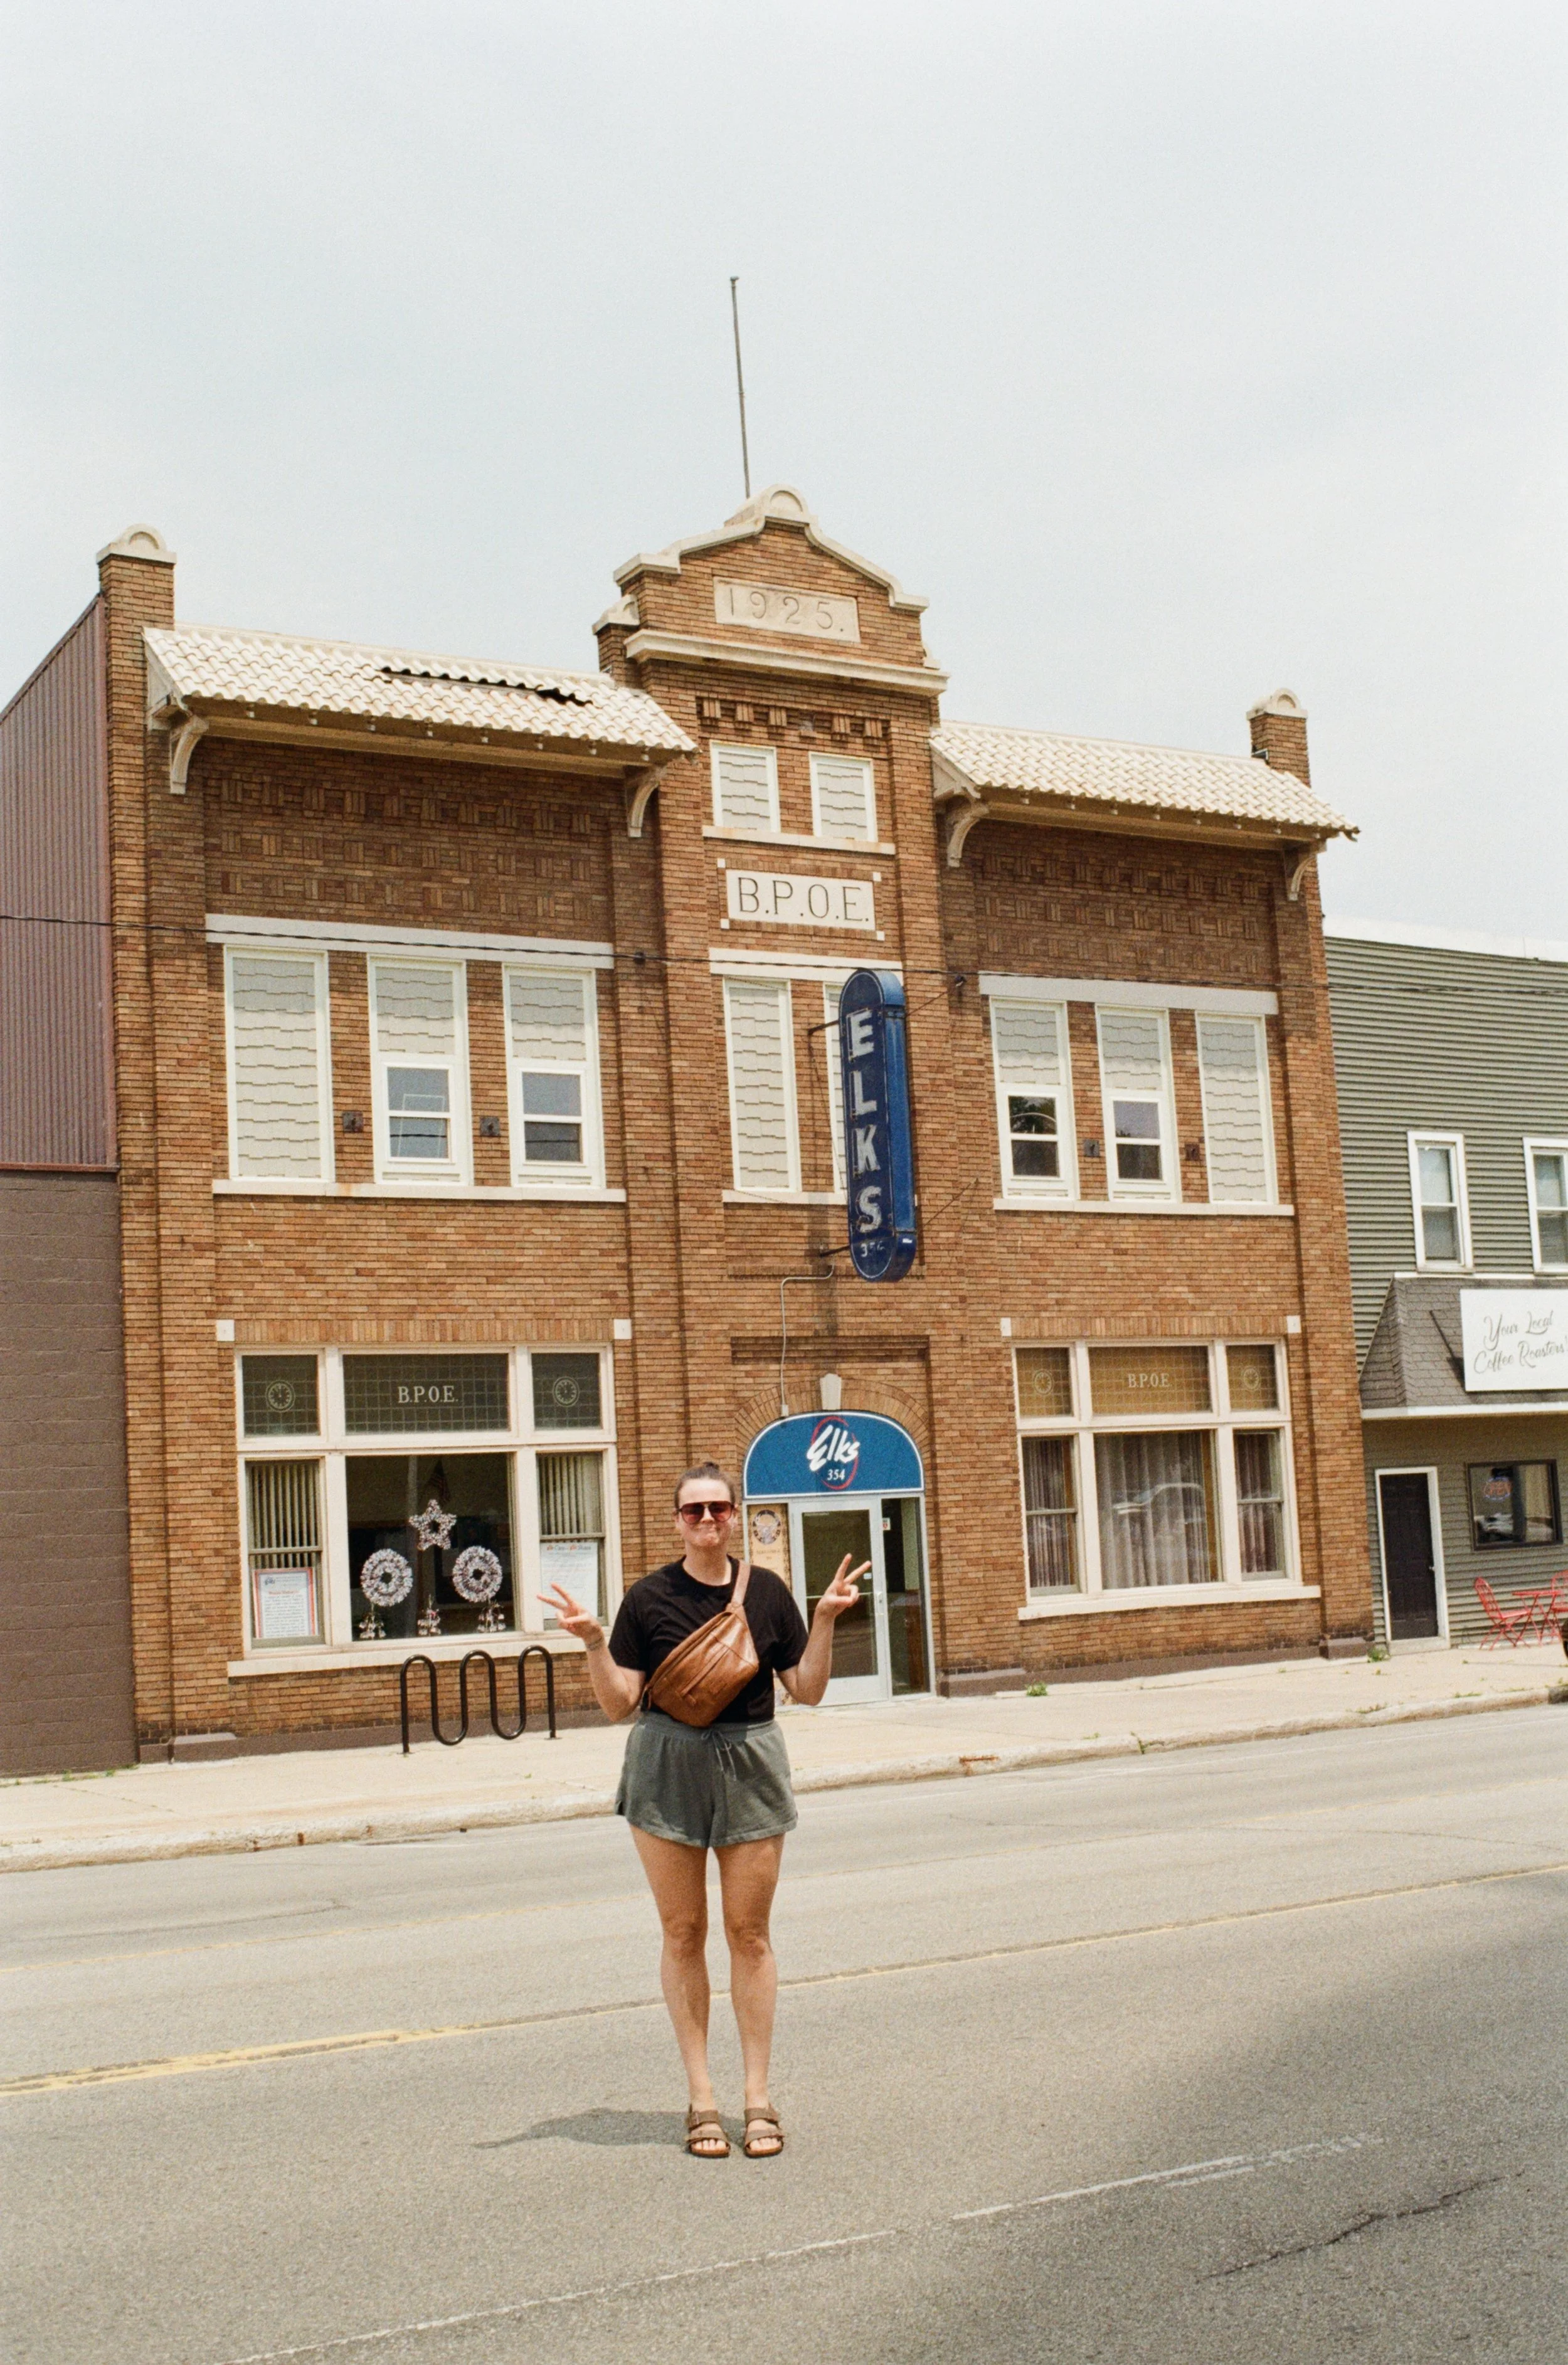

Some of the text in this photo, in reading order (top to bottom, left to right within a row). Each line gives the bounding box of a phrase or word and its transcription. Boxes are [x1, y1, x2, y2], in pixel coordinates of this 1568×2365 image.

[738, 876, 869, 923] B.P.O.E.
[847, 1008, 882, 1234] ELKS
[1483, 1309, 1554, 1352] Your Local
[1473, 1350, 1514, 1374] Coffee
[397, 1384, 459, 1404] B.P.O.E.
[806, 1424, 861, 1472] Elks
[827, 1468, 846, 1481] 354
